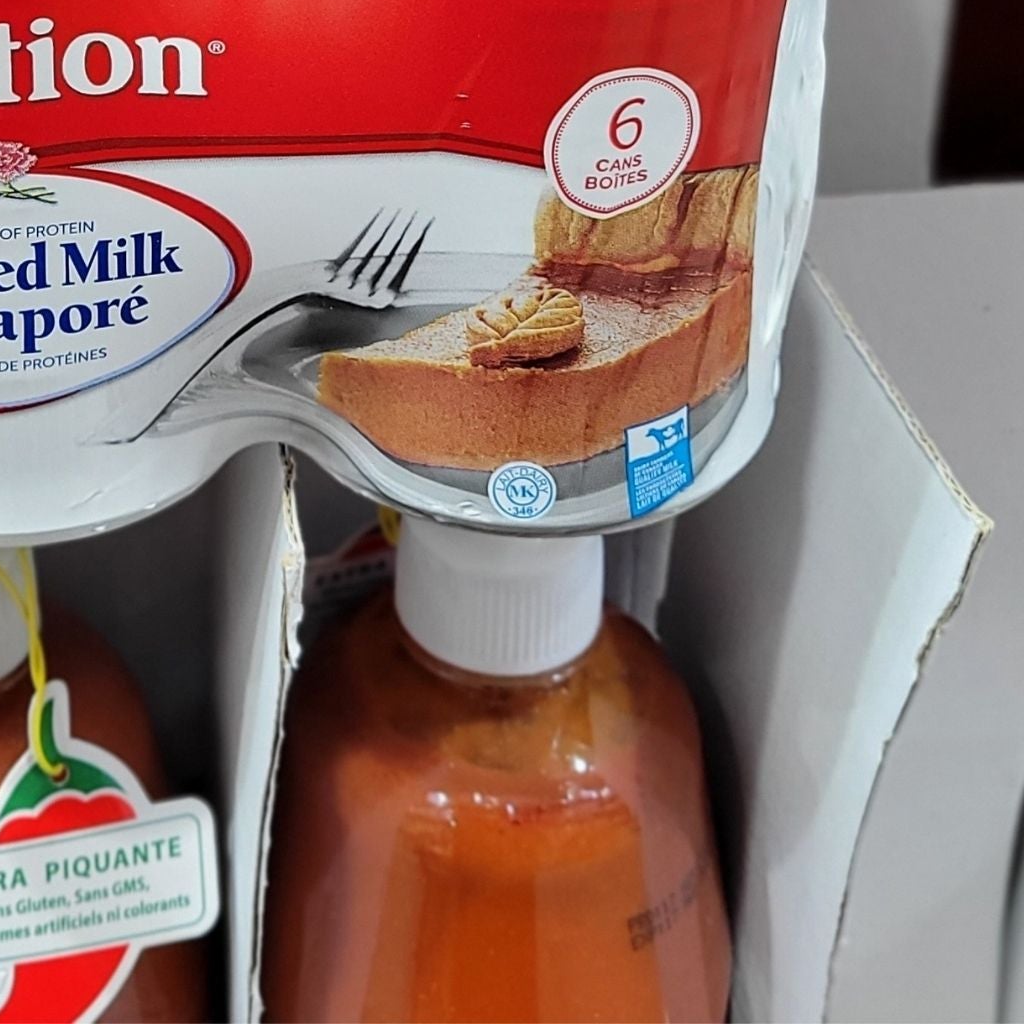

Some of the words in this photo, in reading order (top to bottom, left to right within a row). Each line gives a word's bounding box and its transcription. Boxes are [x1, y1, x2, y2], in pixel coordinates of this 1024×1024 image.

[608, 97, 646, 150] 6
[583, 169, 649, 190] BOÎTES
[595, 154, 643, 173] CANS
[0, 226, 23, 240] OF
[26, 219, 95, 237] PROTEIN
[60, 230, 183, 287] Milk
[22, 345, 108, 372] PROTÉINES
[509, 484, 535, 498] MK
[45, 835, 183, 884] PIQUANTE
[15, 892, 72, 914] Gluten,
[74, 885, 110, 905] Sans
[111, 877, 151, 897] GMS,
[33, 906, 104, 937] artificiels
[106, 904, 122, 918] ni
[123, 893, 191, 919] colorants
